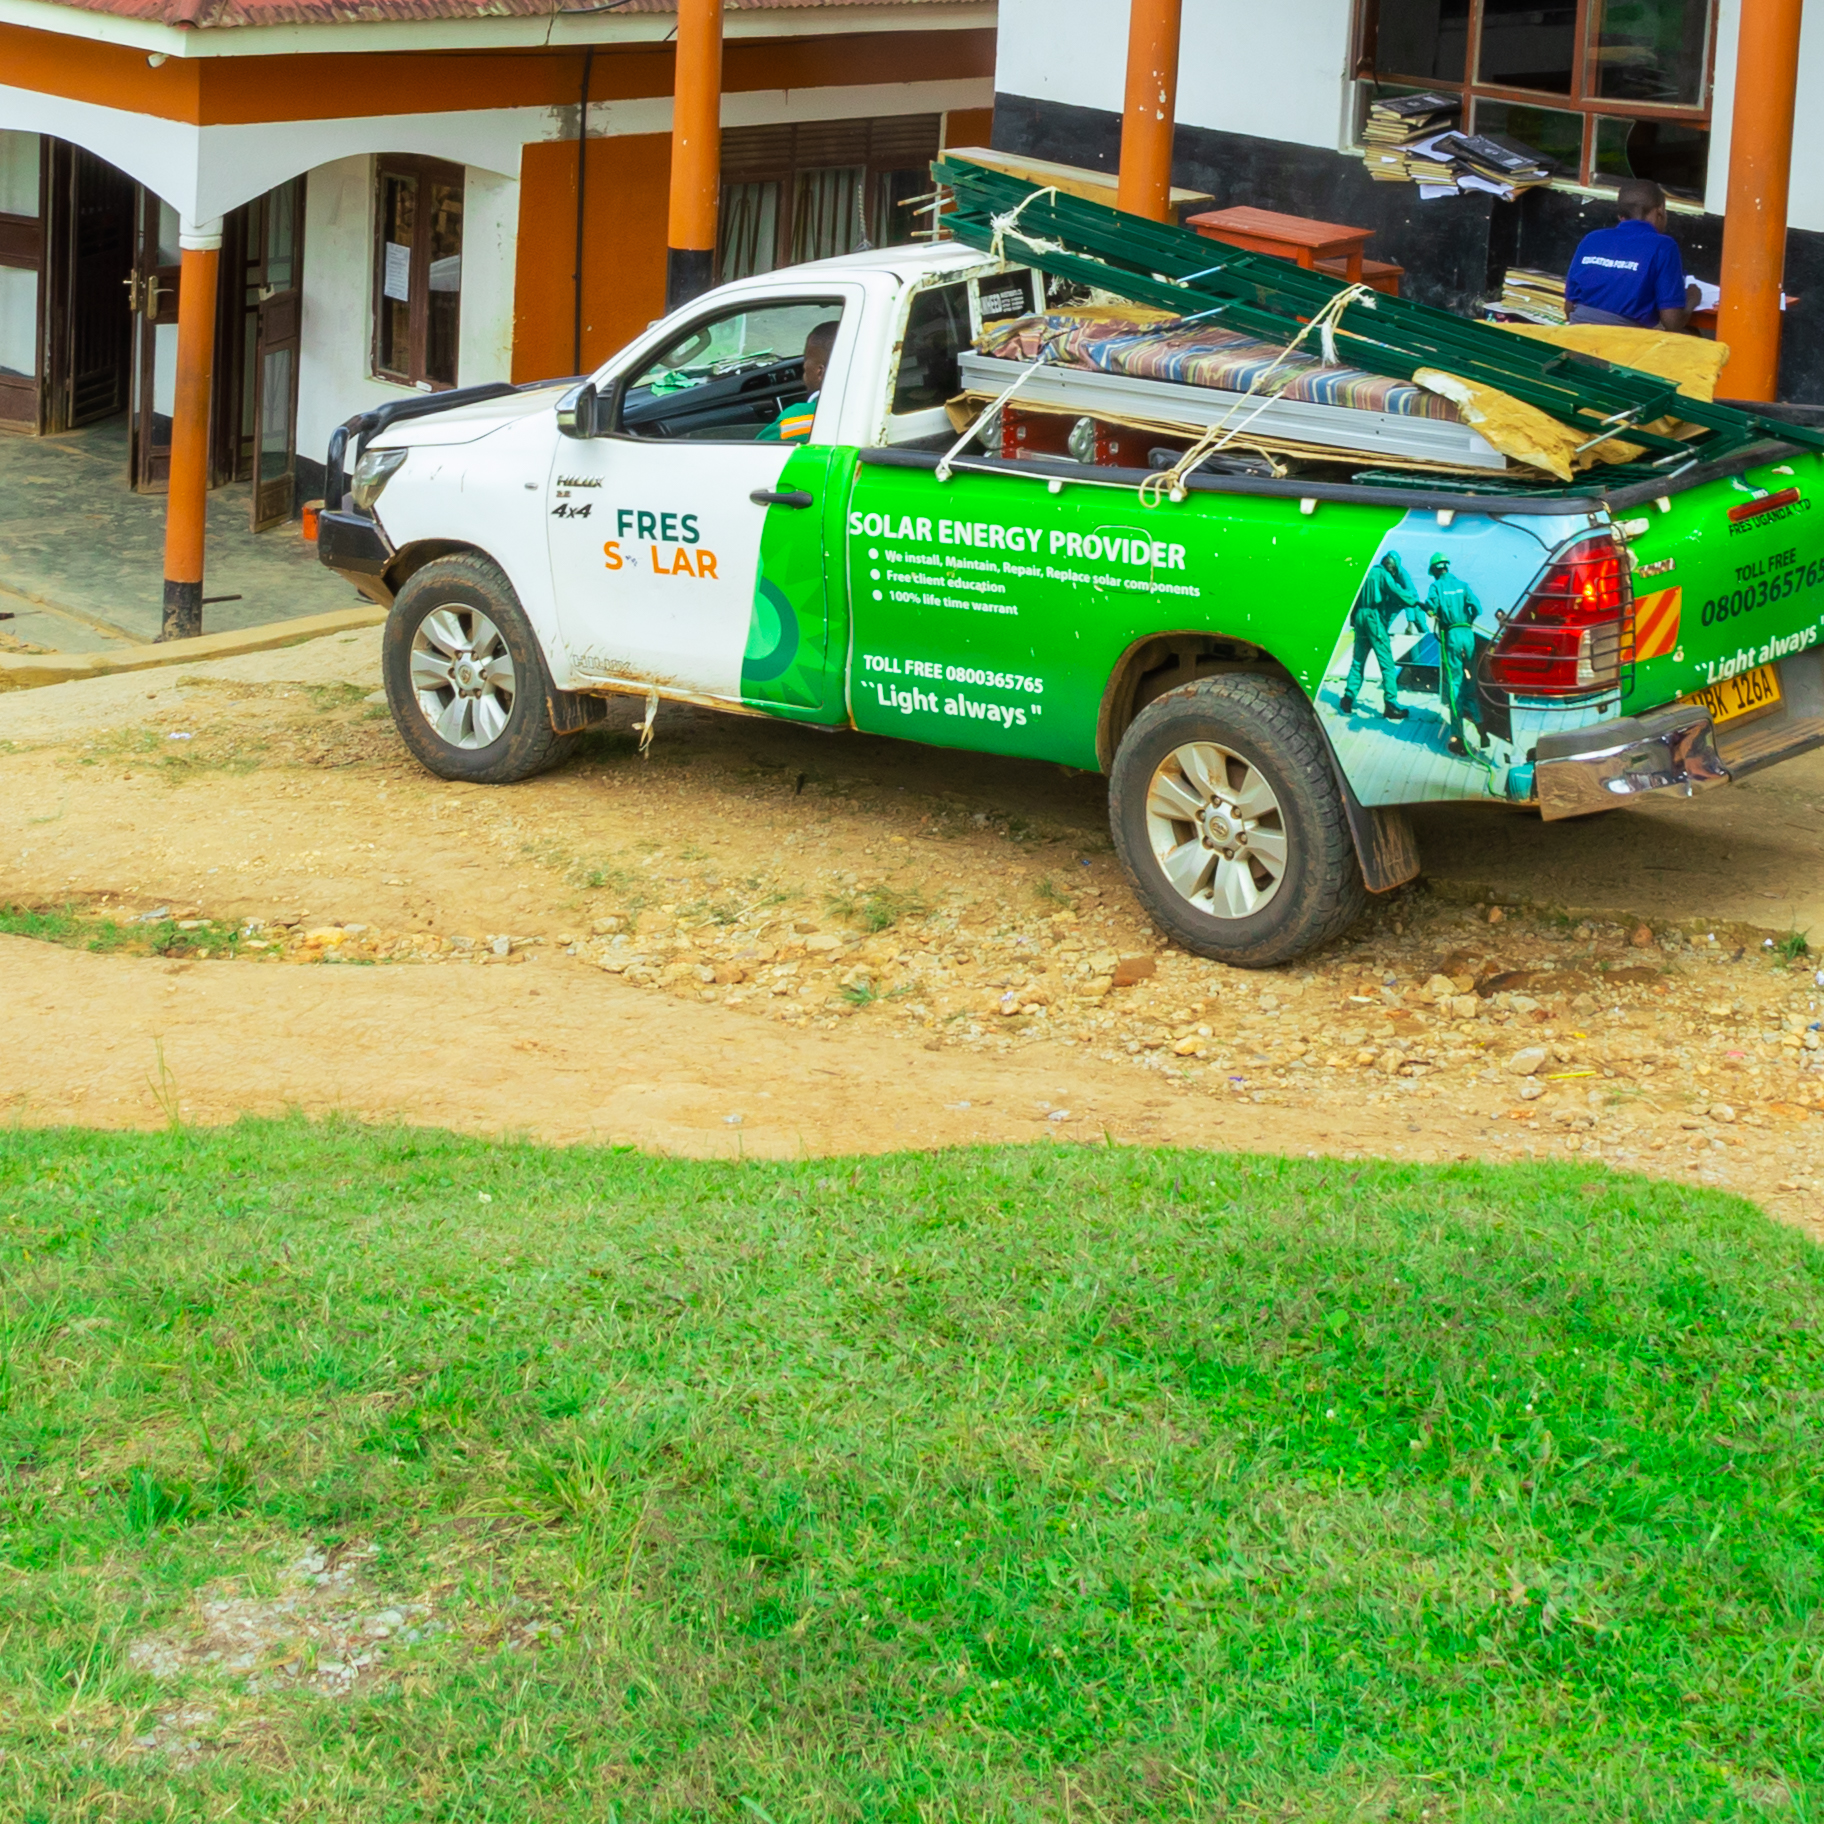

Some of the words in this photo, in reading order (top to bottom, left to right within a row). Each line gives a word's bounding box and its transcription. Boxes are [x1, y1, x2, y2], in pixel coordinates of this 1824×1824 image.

[1581, 256, 1613, 268] EDUCATION
[617, 508, 701, 544] FRES
[1728, 520, 1753, 537] FRES
[1753, 507, 1794, 531] UGANDA
[849, 511, 933, 542] SOLAR
[938, 519, 1044, 553] ENERGY
[1049, 530, 1187, 570] PROVIDER
[603, 540, 720, 580] SLAR
[884, 549, 904, 563] We
[904, 551, 944, 567] install,
[945, 555, 1001, 573] Maintain,
[1002, 561, 1044, 578] Repair,
[1045, 566, 1091, 583] Replace
[1092, 573, 1122, 587] solar
[1123, 579, 1201, 597] components
[1734, 560, 1766, 582] TOLL
[1768, 547, 1797, 573] FREE
[886, 570, 912, 583] Free
[913, 573, 946, 587] client
[947, 577, 1006, 594] education
[889, 590, 922, 605] 100%
[922, 593, 942, 607] life
[943, 596, 970, 610] time
[971, 601, 1019, 616] warrant
[1758, 625, 1818, 664] always
[863, 654, 902, 674] TOLL
[905, 659, 943, 679] FREE
[945, 666, 1044, 694] 0800365765
[1732, 668, 1774, 709] 126A
[944, 693, 1027, 729] always
